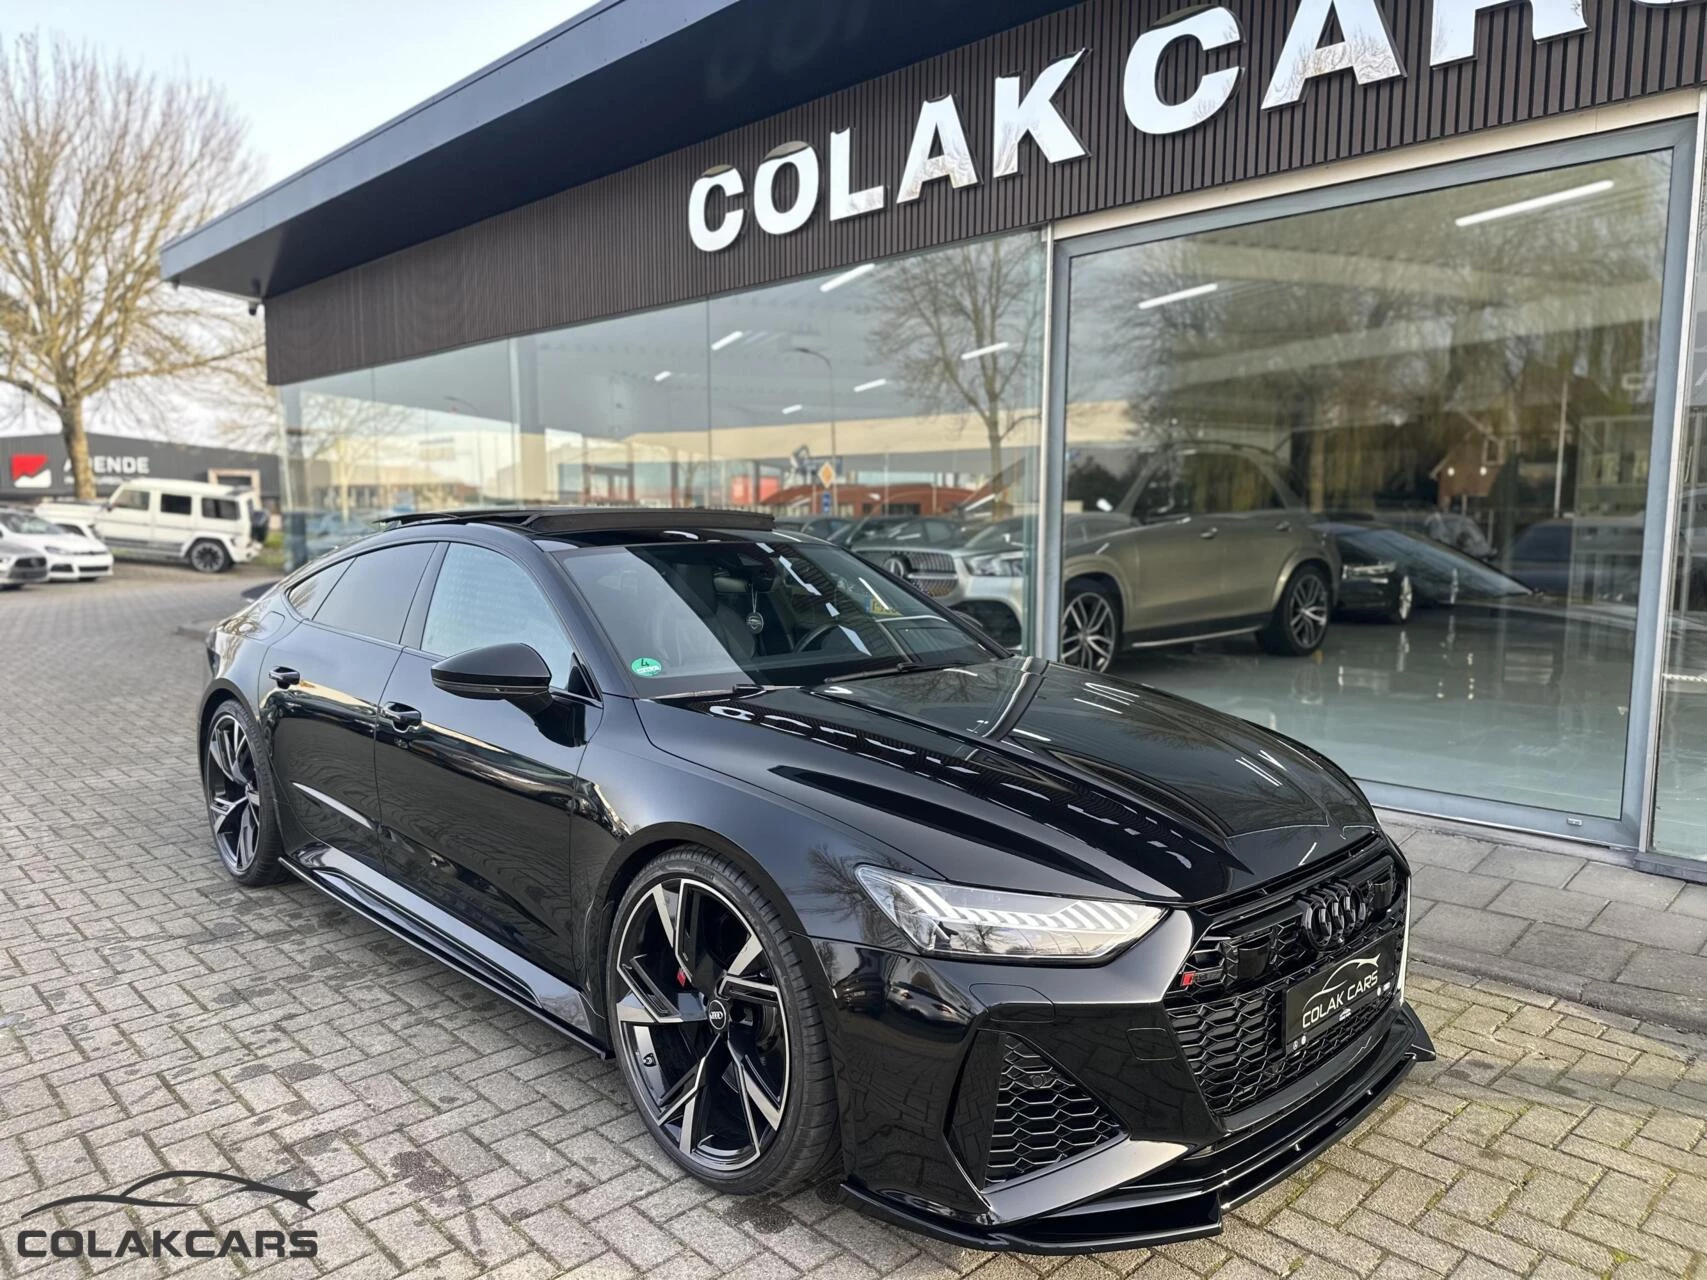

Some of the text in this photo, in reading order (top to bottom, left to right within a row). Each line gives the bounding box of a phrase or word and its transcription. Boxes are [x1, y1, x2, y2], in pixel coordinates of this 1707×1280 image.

[688, 0, 1707, 251] COLAK CA
[64, 456, 149, 473] ENDE
[1303, 970, 1378, 1028] COLAK CARS
